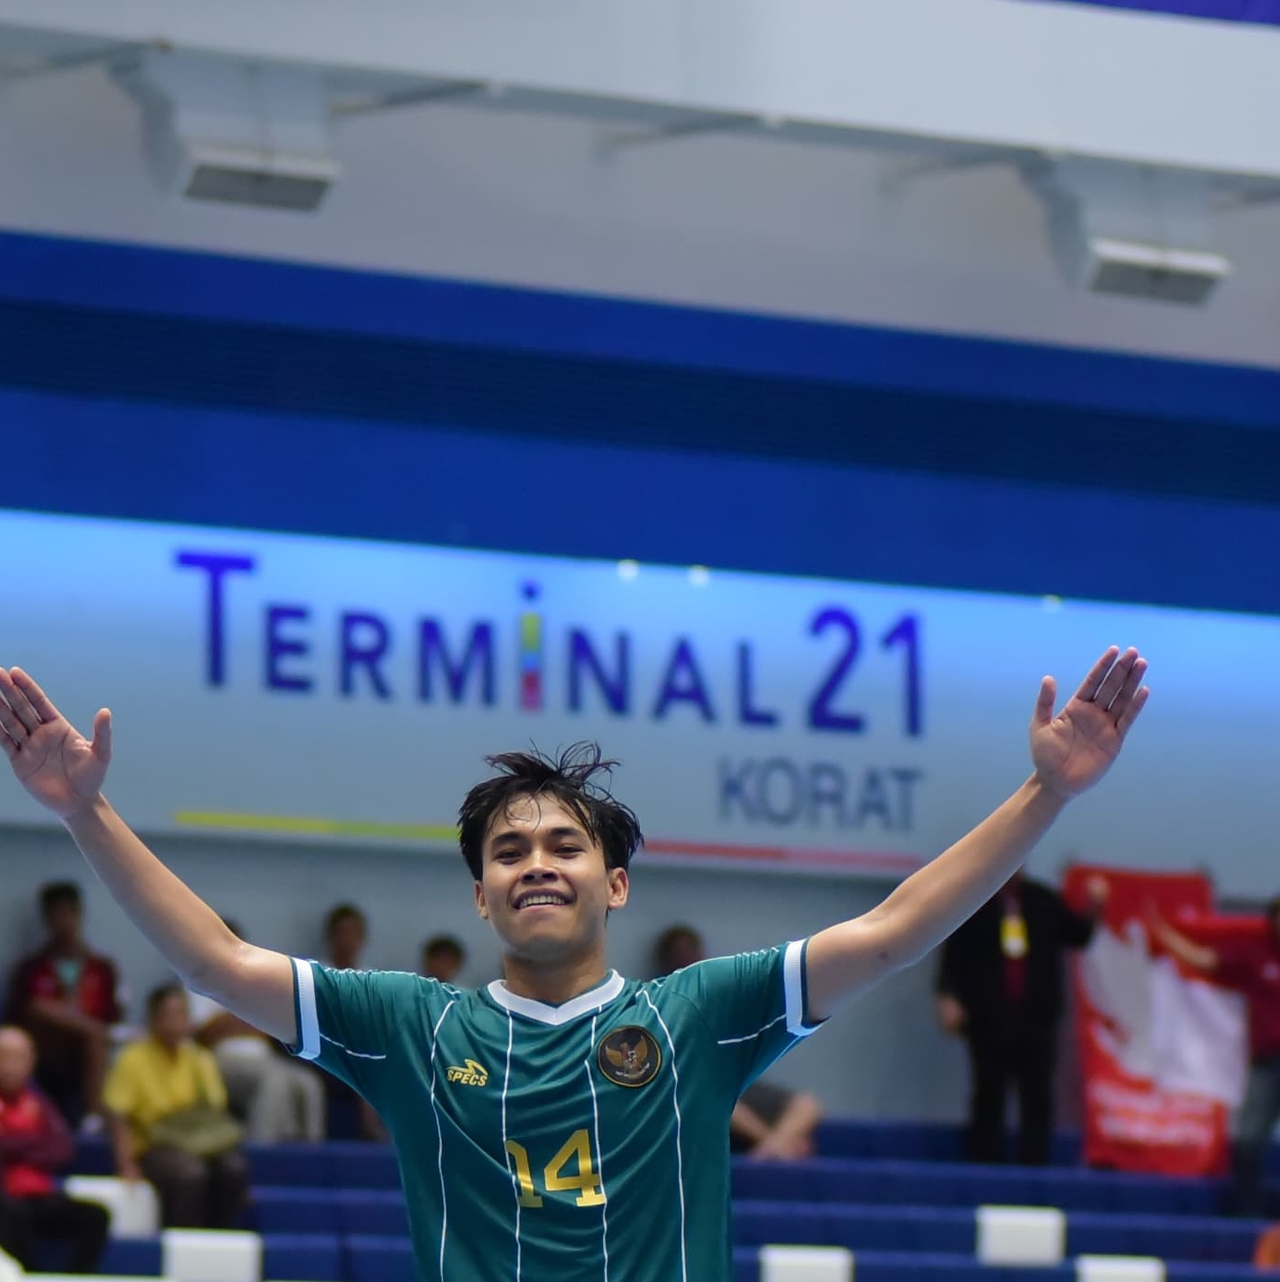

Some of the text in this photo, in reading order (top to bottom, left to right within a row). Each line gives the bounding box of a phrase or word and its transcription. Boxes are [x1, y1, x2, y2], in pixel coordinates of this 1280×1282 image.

[722, 754, 922, 832] KORAT
[447, 1069, 488, 1087] SPECS
[506, 1129, 606, 1208] 14
